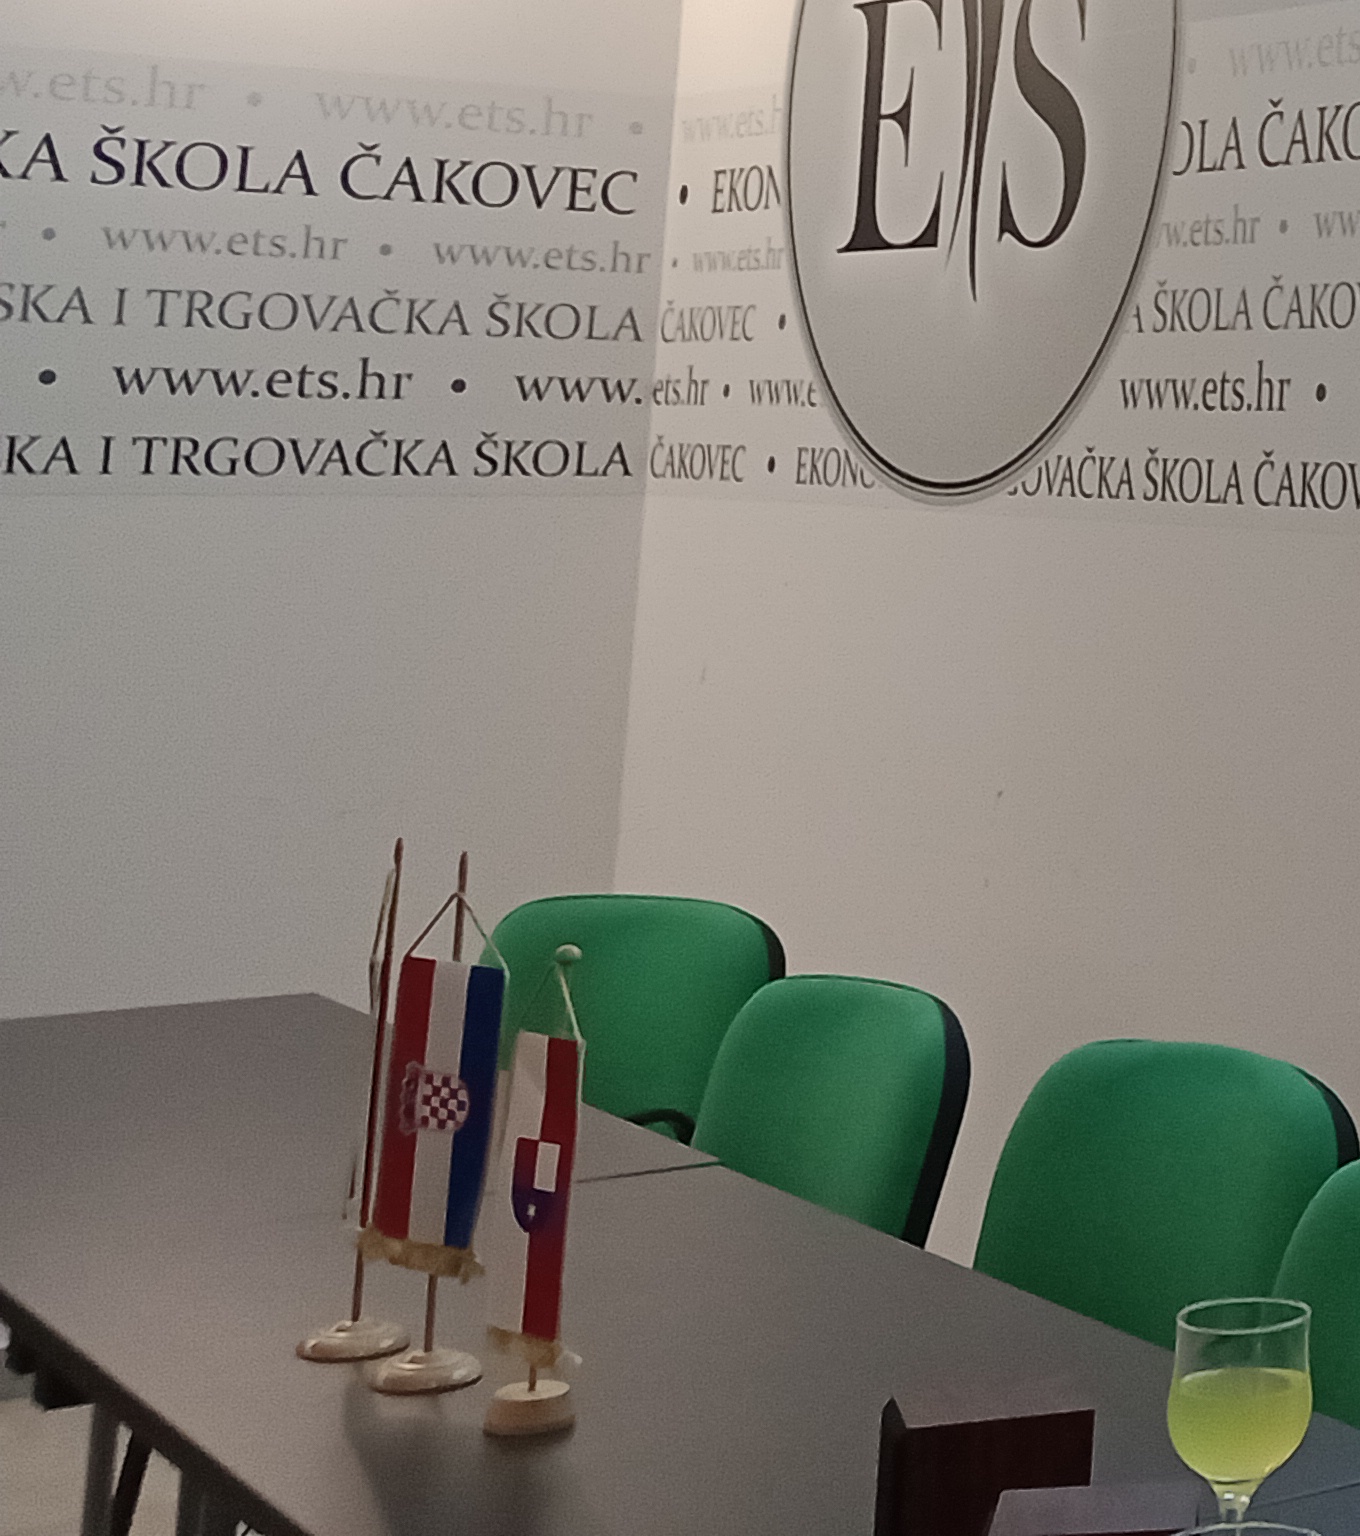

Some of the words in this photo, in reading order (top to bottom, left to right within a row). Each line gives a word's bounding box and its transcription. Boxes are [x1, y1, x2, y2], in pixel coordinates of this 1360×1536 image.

[314, 91, 594, 138] www.ets.hr
[90, 123, 319, 197] ŠKOLA
[340, 142, 639, 215] ČAKOVEC
[103, 224, 348, 261] www.ets.hr
[433, 240, 651, 275] www.ets.hr
[113, 287, 128, 328] I
[146, 288, 470, 337] TRGOVAČKA
[486, 293, 643, 343] ŠKOLA
[660, 300, 757, 343] ČAKOVEC
[1152, 280, 1254, 333] ŠKOLA
[112, 357, 413, 400] www.ets.hr
[1120, 360, 1292, 413] www.ets.hr
[98, 435, 116, 476] I
[131, 430, 459, 478] TRGOVAČKA
[473, 431, 633, 478] ŠKOLA
[650, 435, 747, 483] ČAKOVEC
[1143, 447, 1245, 506] ŠKOLA
